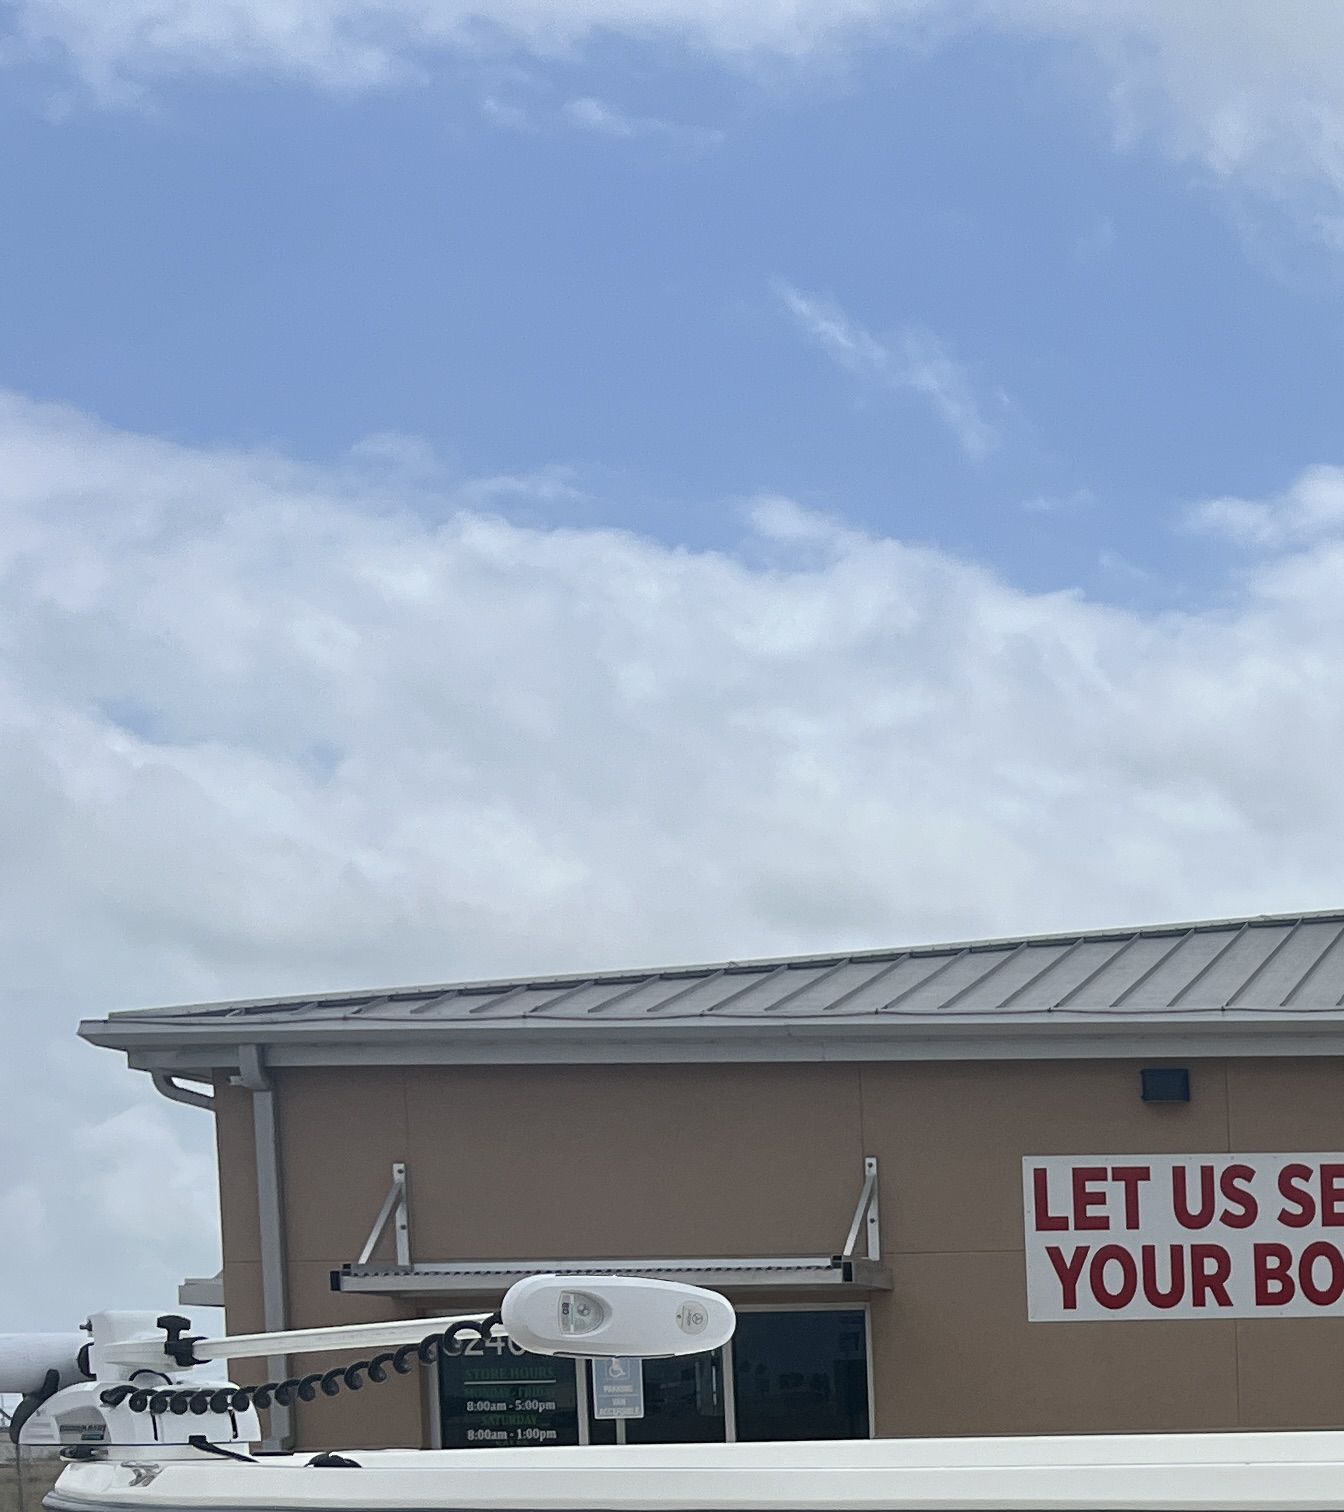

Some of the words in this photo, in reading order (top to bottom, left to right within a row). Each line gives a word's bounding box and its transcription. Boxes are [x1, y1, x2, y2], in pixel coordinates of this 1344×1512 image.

[1033, 1166, 1151, 1231] LET
[1172, 1163, 1259, 1229] US
[1046, 1243, 1233, 1310] YOUR
[466, 1401, 507, 1412] 8:00am
[515, 1400, 556, 1413] 5:00pm
[467, 1429, 508, 1440] 8:00am
[517, 1428, 557, 1442] 1:00pm
